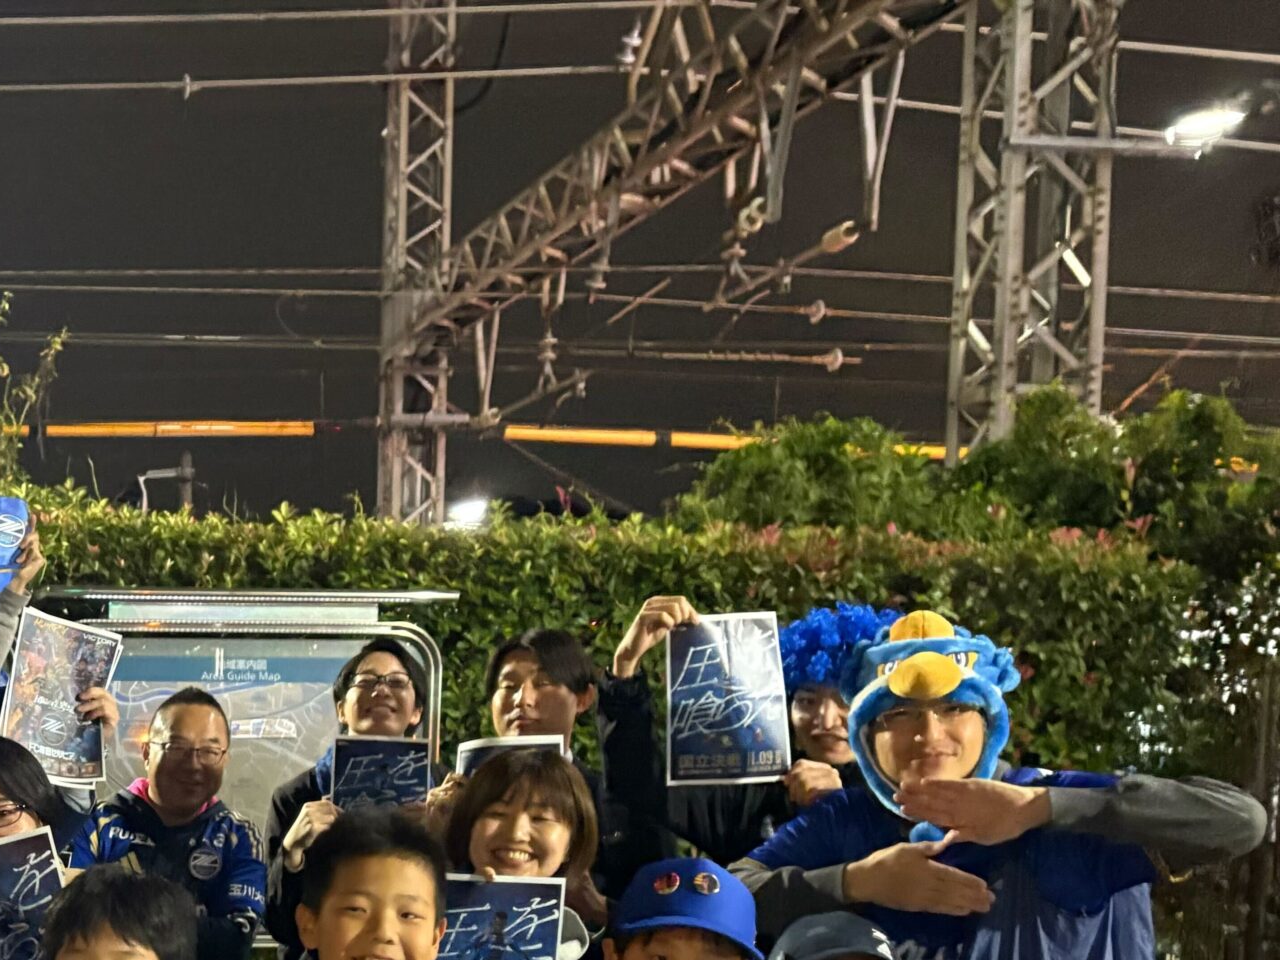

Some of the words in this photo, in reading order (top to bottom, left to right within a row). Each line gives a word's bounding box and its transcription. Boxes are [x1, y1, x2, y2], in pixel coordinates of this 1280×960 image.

[214, 658, 267, 671] 域案内図
[227, 671, 256, 681] Guide
[259, 671, 281, 682] Map
